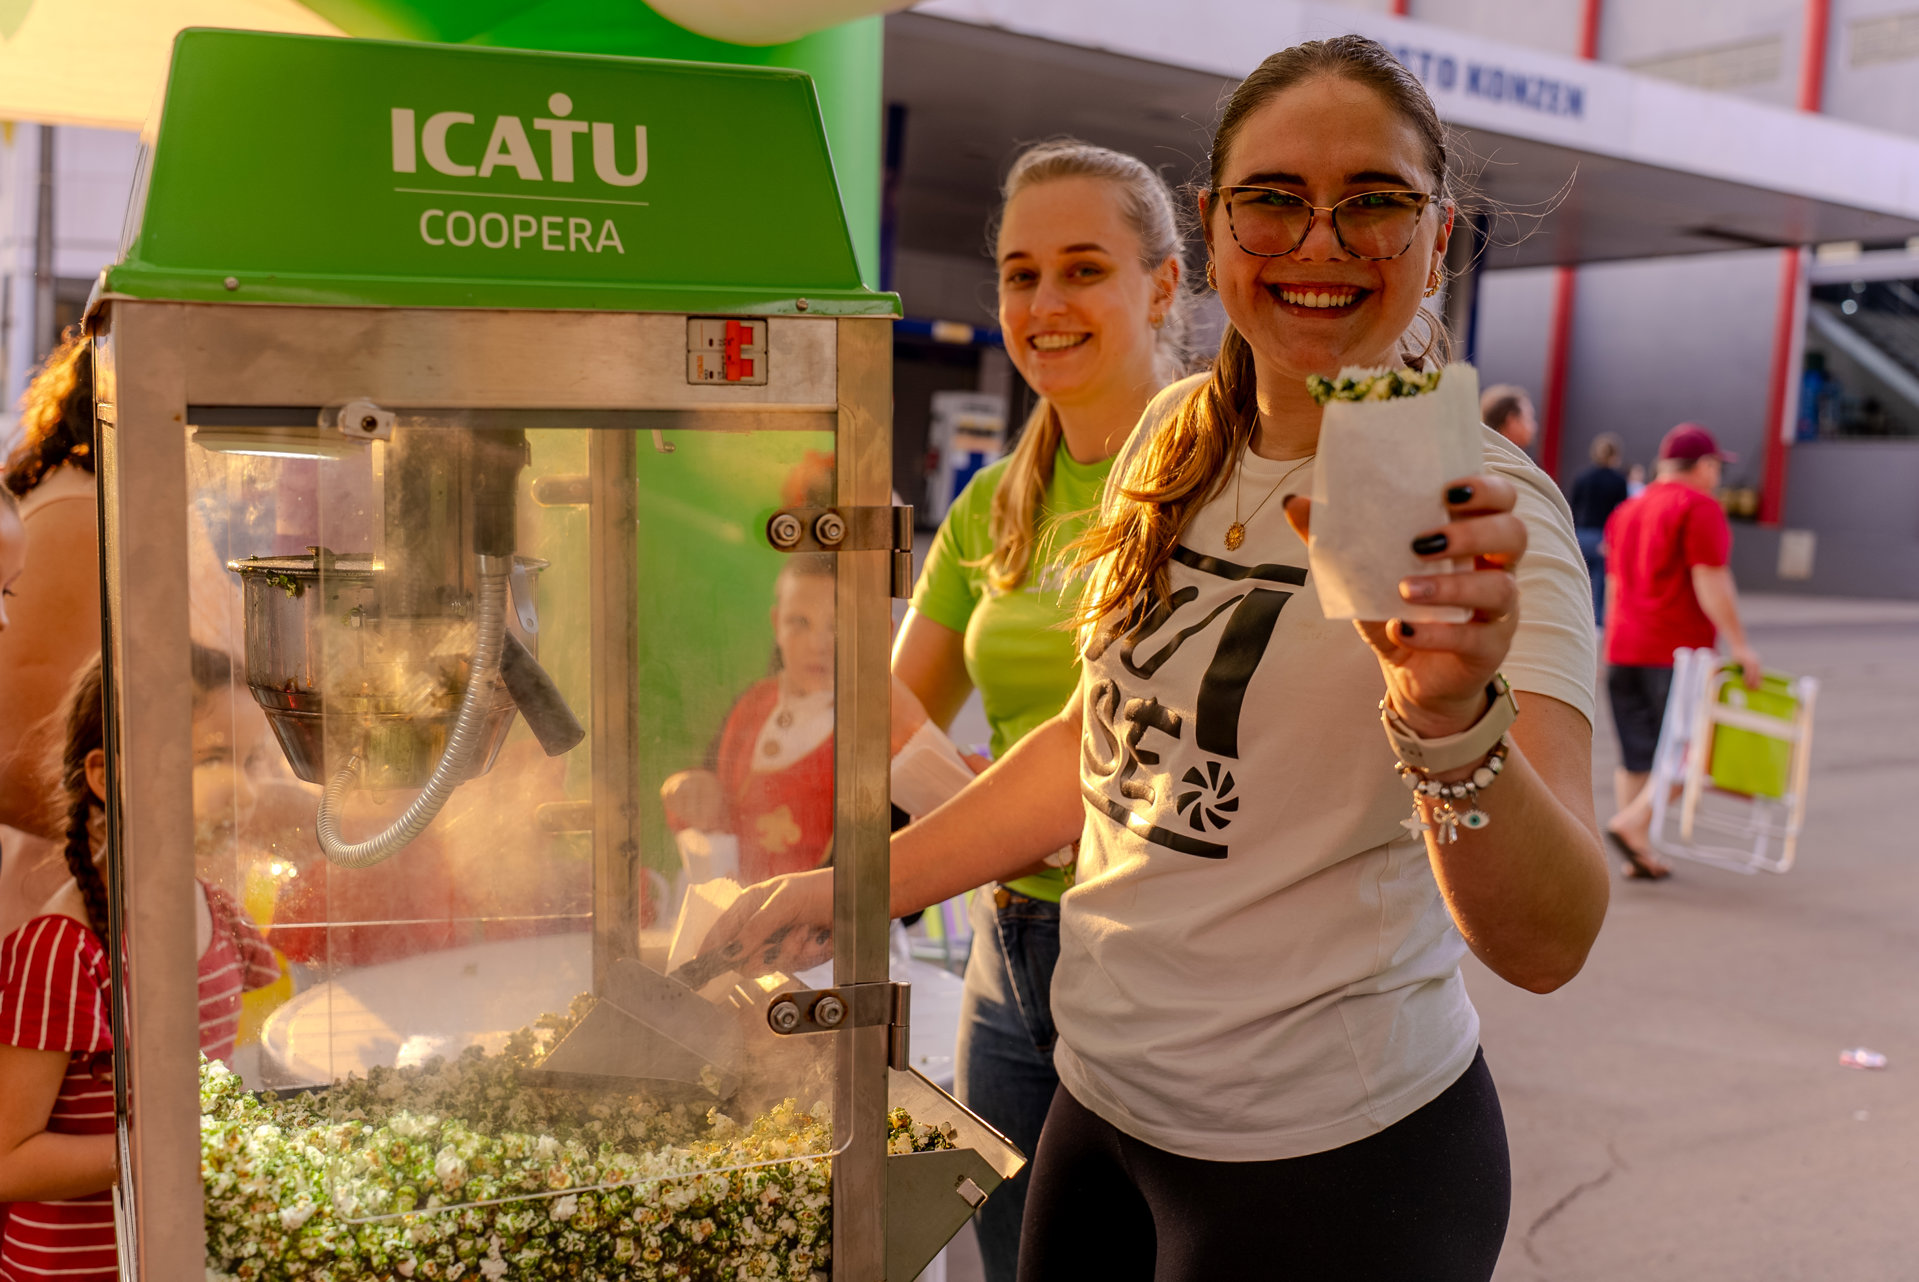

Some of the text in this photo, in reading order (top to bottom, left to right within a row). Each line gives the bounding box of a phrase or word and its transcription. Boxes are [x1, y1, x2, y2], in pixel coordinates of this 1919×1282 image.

[1466, 64, 1584, 118] KONZEN
[391, 92, 649, 187] ICATU
[419, 208, 625, 254] COOPERA
